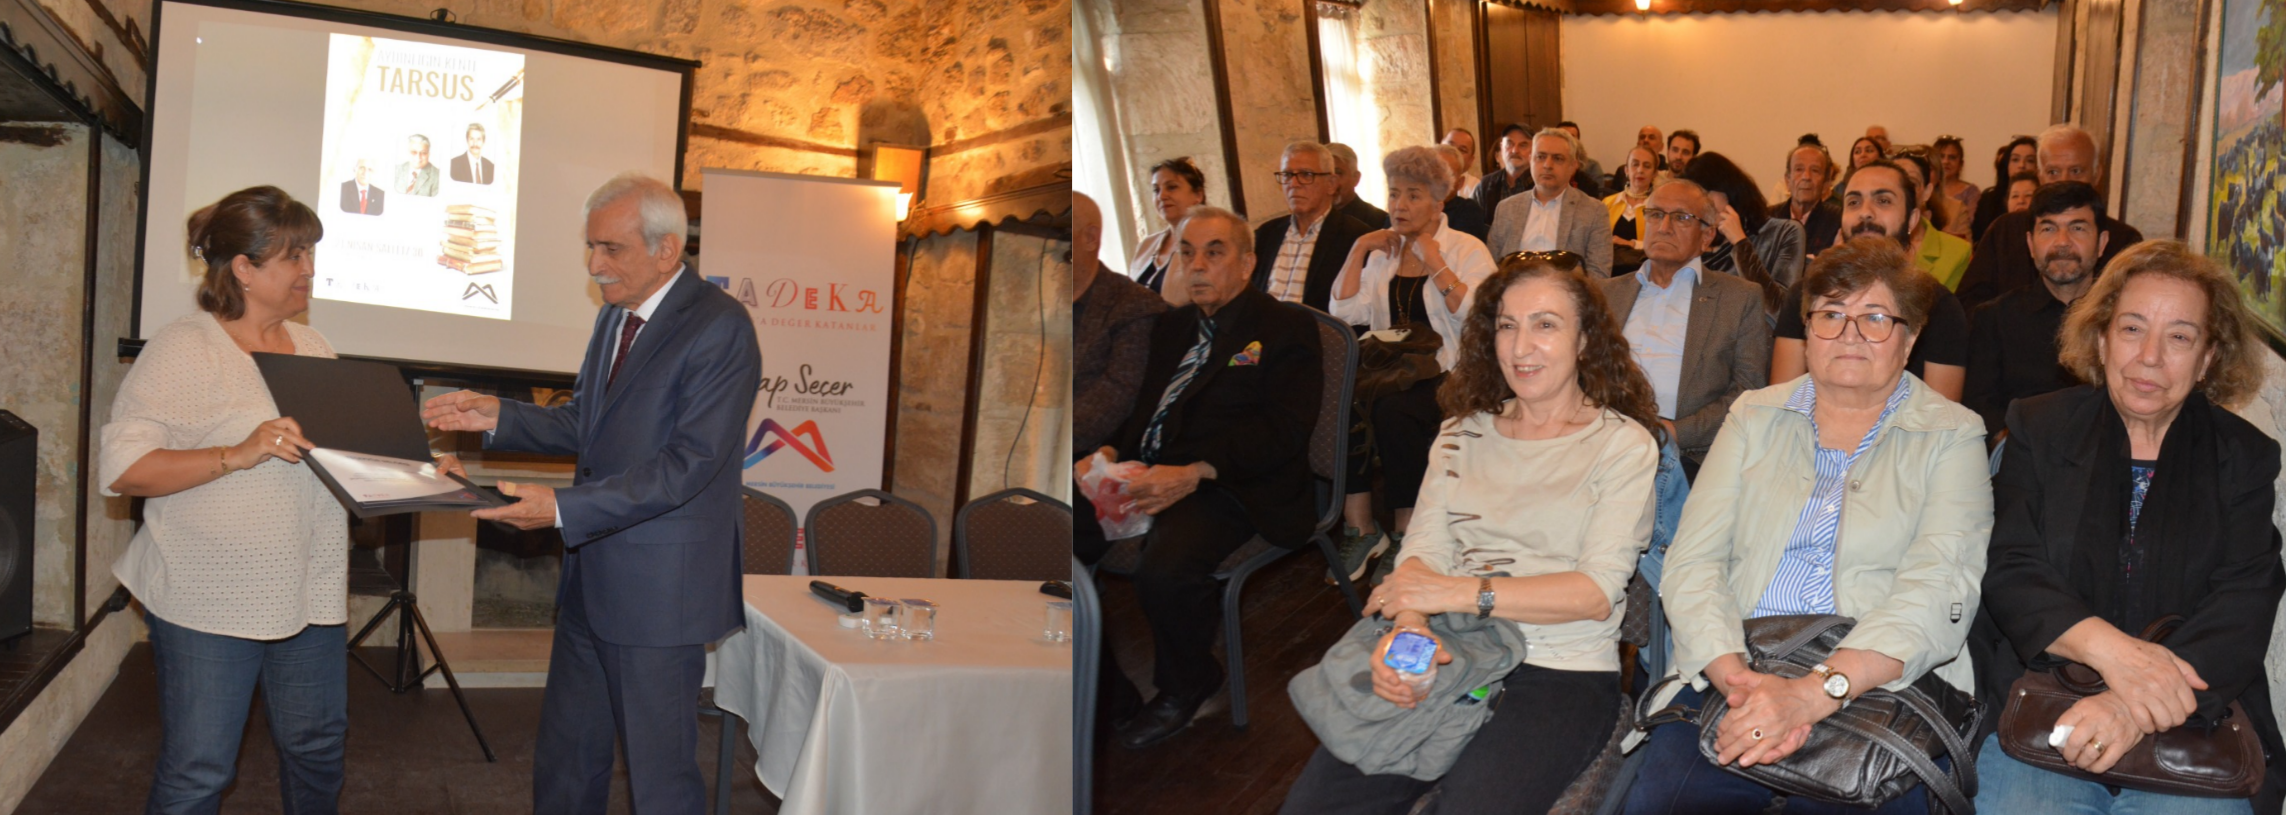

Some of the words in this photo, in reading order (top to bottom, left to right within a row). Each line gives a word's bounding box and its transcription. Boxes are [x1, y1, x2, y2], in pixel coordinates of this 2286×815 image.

[377, 65, 475, 102] TARSUS
[815, 319, 876, 331] KATANLAR
[794, 363, 854, 397] Seçer
